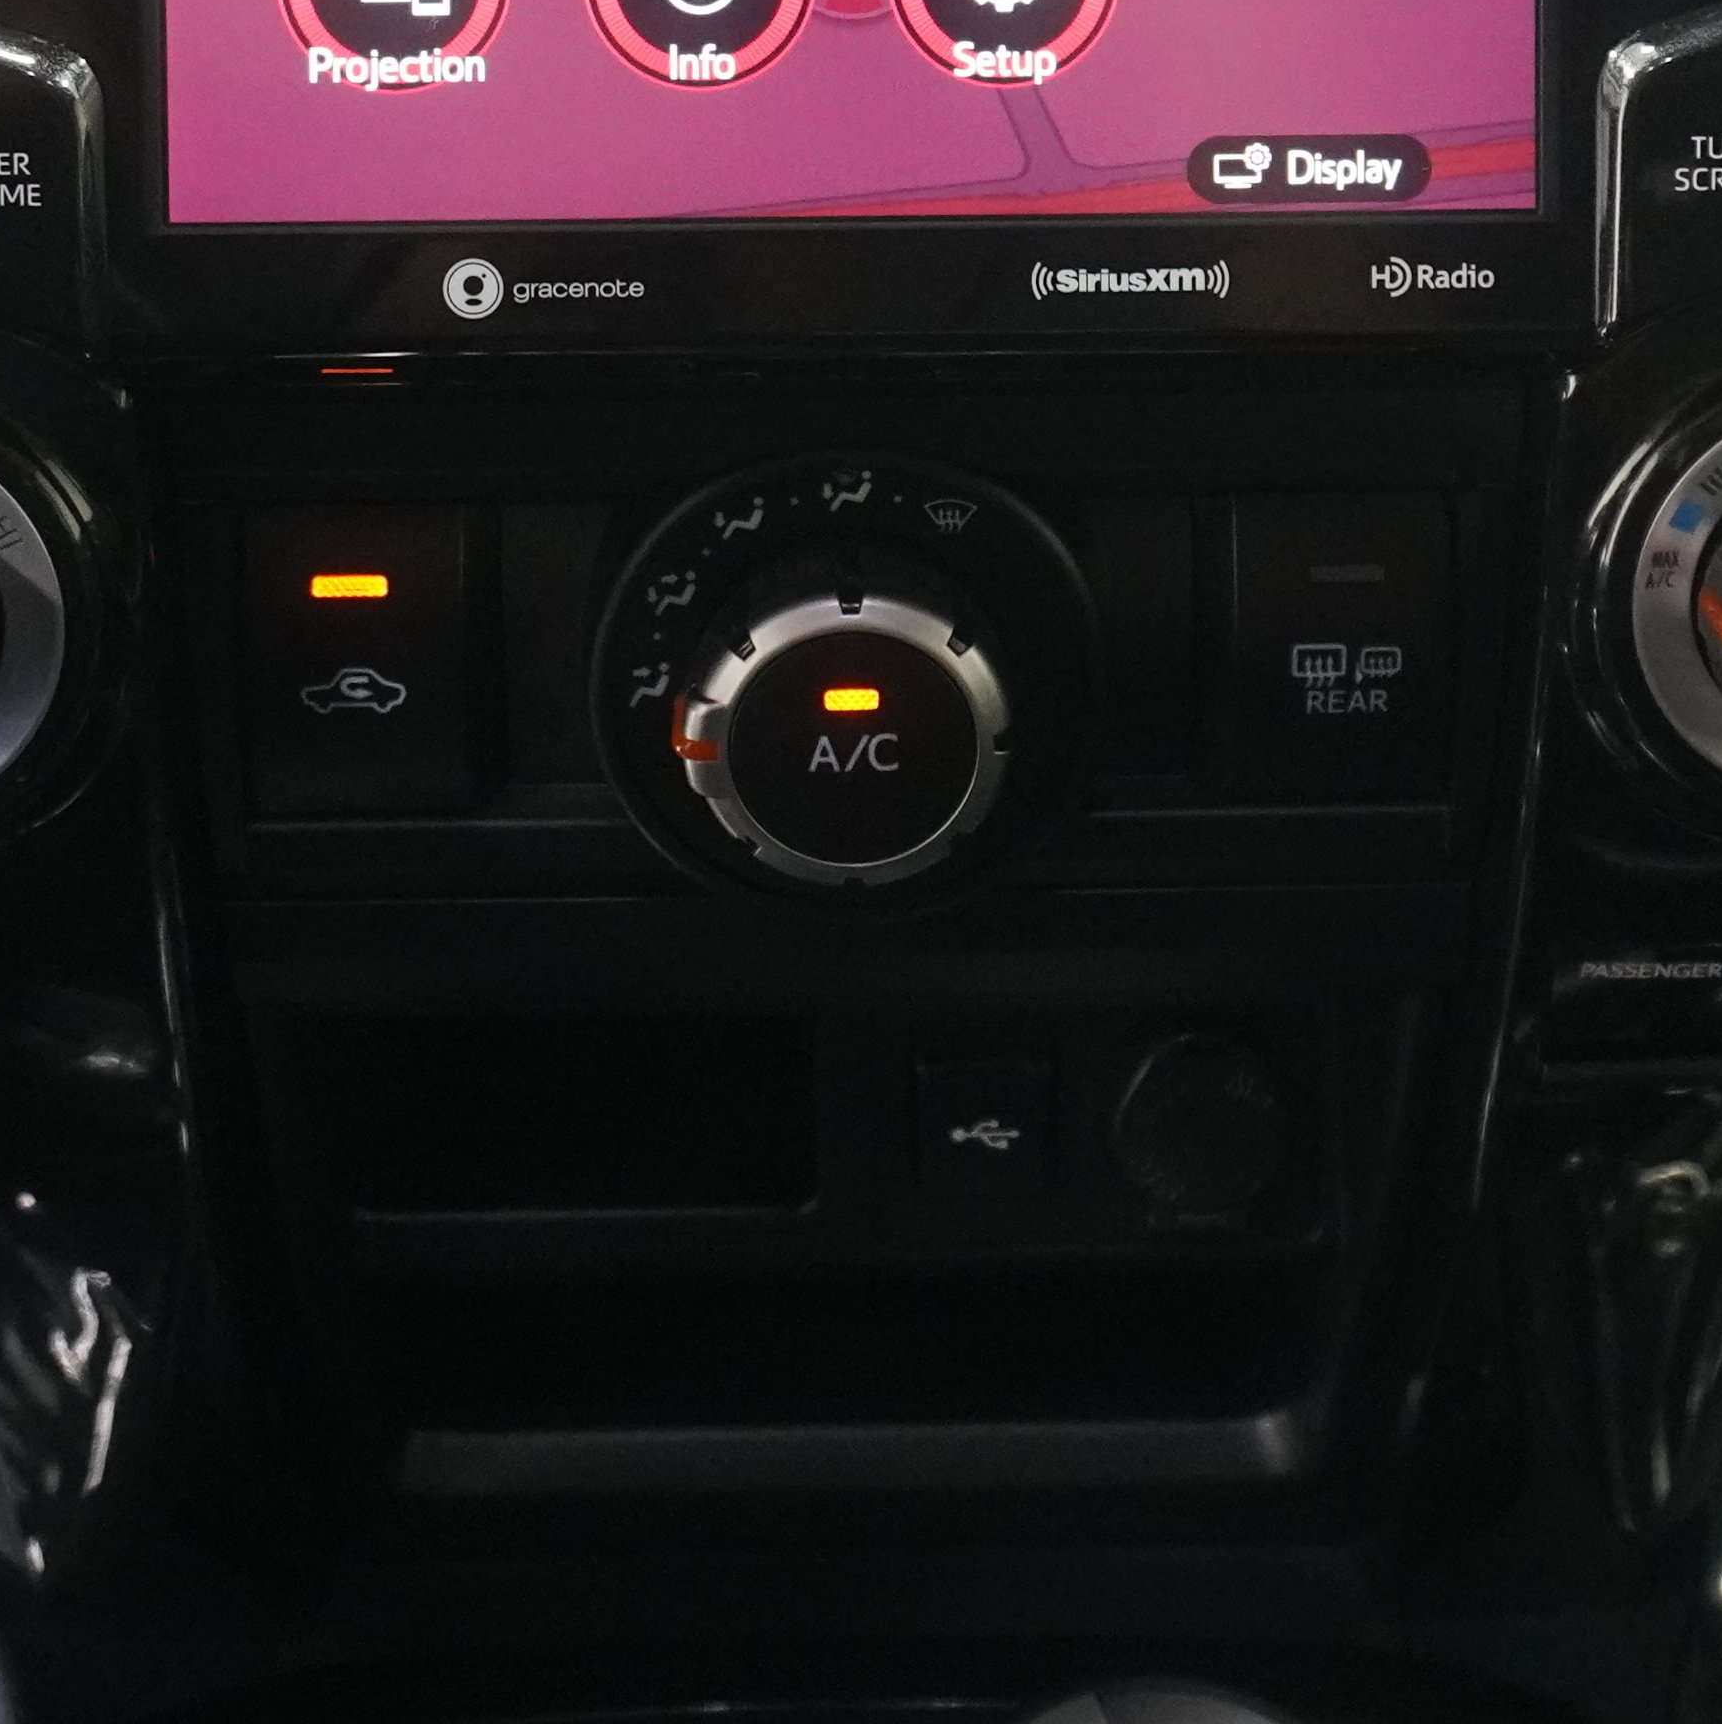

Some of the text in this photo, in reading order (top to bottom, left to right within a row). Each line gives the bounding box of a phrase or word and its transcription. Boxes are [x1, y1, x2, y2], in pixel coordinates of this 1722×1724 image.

[307, 46, 486, 92] Projection
[668, 43, 737, 81] Info
[952, 40, 1057, 85] Setup
[1286, 149, 1403, 191] Display
[512, 277, 645, 304] gracenote
[1416, 261, 1496, 290] Radio
[1306, 689, 1389, 715] REAR
[808, 732, 900, 773] A/C
